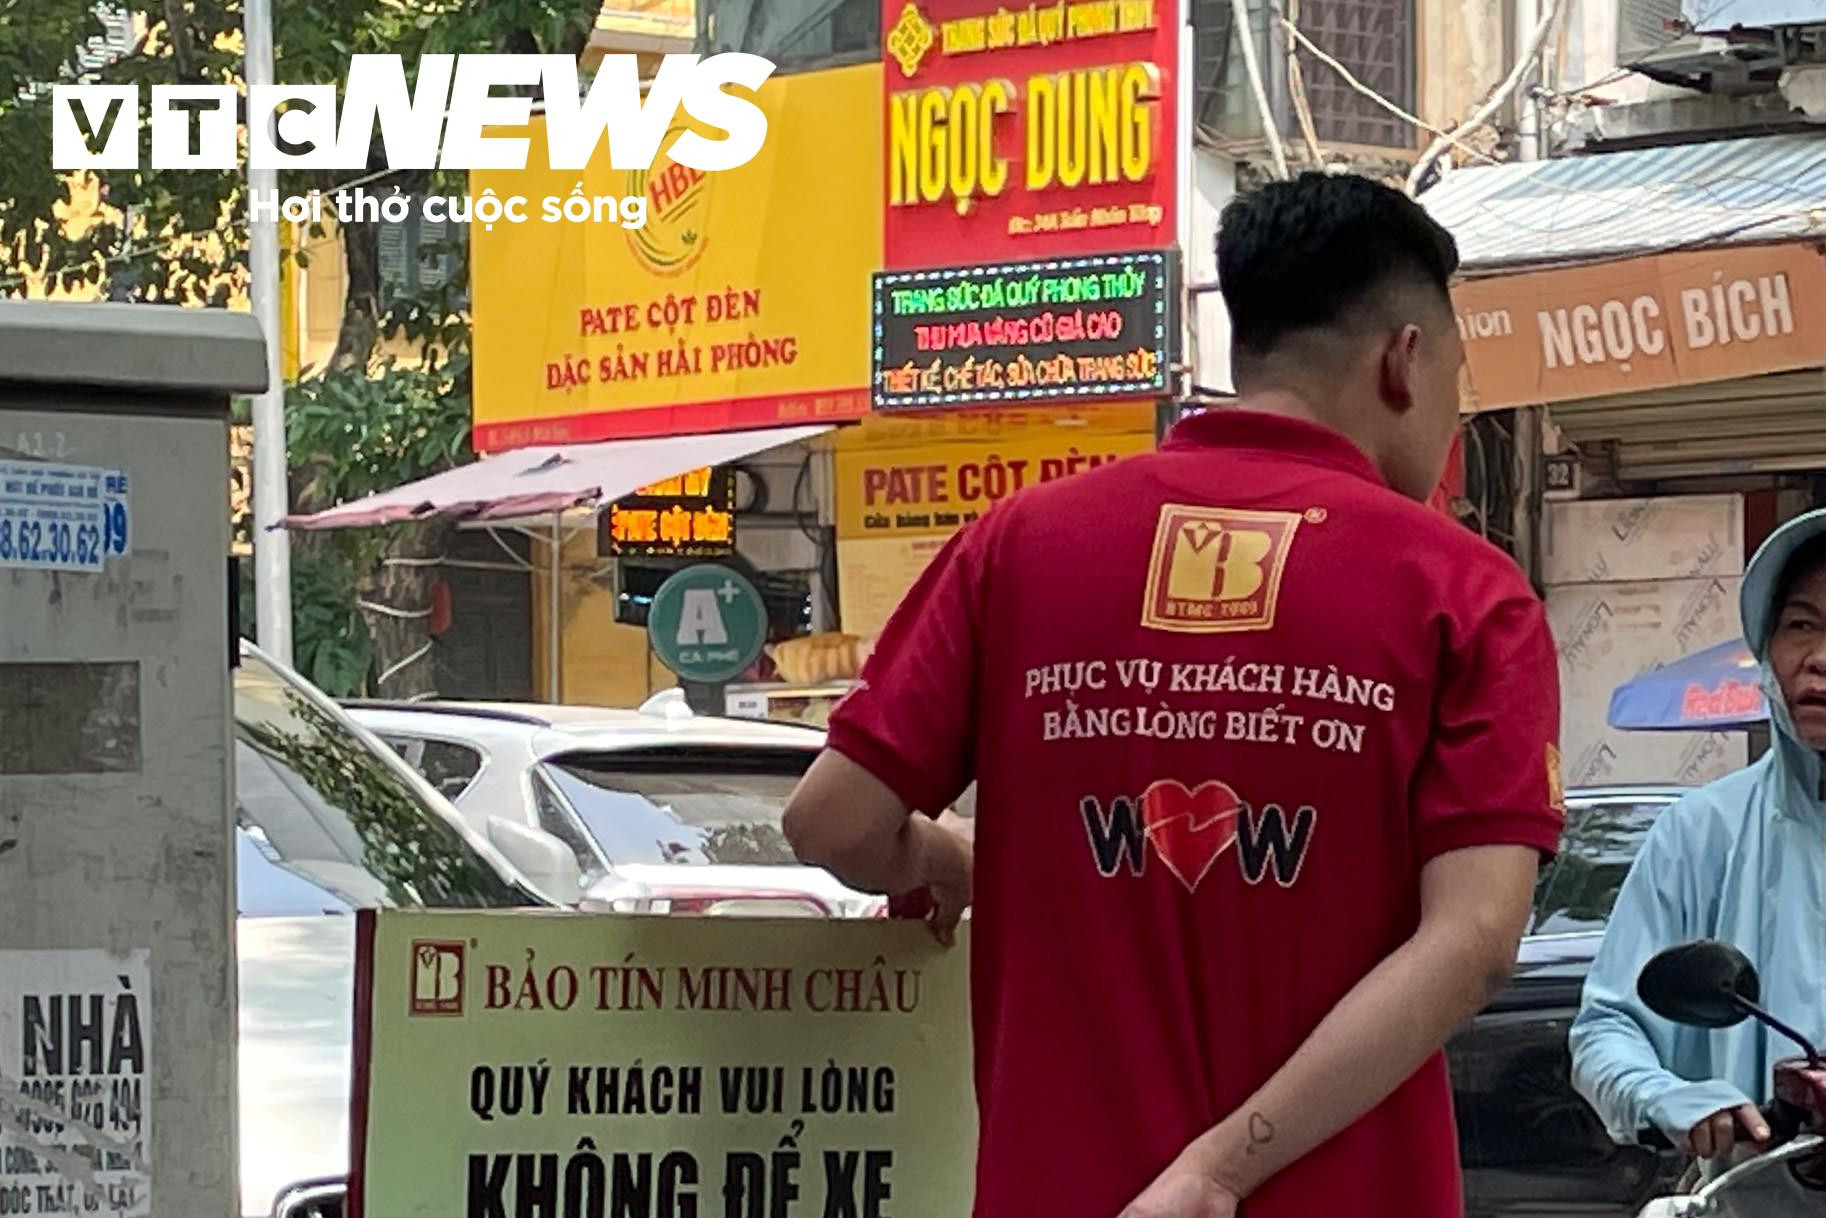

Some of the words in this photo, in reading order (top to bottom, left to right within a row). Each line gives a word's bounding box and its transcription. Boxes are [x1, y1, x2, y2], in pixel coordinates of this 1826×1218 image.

[890, 80, 1010, 215] NGỌC
[1027, 64, 1152, 190] DUNG
[580, 304, 639, 336] PATE
[647, 293, 697, 334] CỘT
[706, 285, 761, 322] ĐÈN
[1042, 273, 1100, 302] PHONG
[1537, 294, 1666, 373] NGỌC
[1681, 270, 1794, 349] BÍCH
[546, 354, 591, 394] ĐẶC
[600, 343, 648, 383] SẢN
[657, 337, 702, 378] HẢI
[711, 332, 797, 373] PHÒNG
[864, 465, 947, 507] PATE
[1547, 463, 1570, 487] 32
[1025, 660, 1106, 698] PHỤC
[1116, 658, 1163, 694] VỤ
[1168, 655, 1285, 693] KHÁCH
[1291, 664, 1396, 711] HÀNG
[1043, 698, 1131, 740] BẰNG
[1135, 701, 1217, 740] LÒNG
[1224, 703, 1304, 744] BIẾT
[484, 948, 578, 1012] BẢO
[590, 953, 667, 1011] TÍN
[671, 965, 794, 1012] MINH
[804, 956, 922, 1013] CHÂU
[22, 975, 145, 1076] NHÀ
[470, 1057, 551, 1121] QUÝ
[568, 1058, 702, 1115] KHÁCH
[719, 1066, 784, 1114] VUI
[800, 1058, 896, 1114] LÒNG
